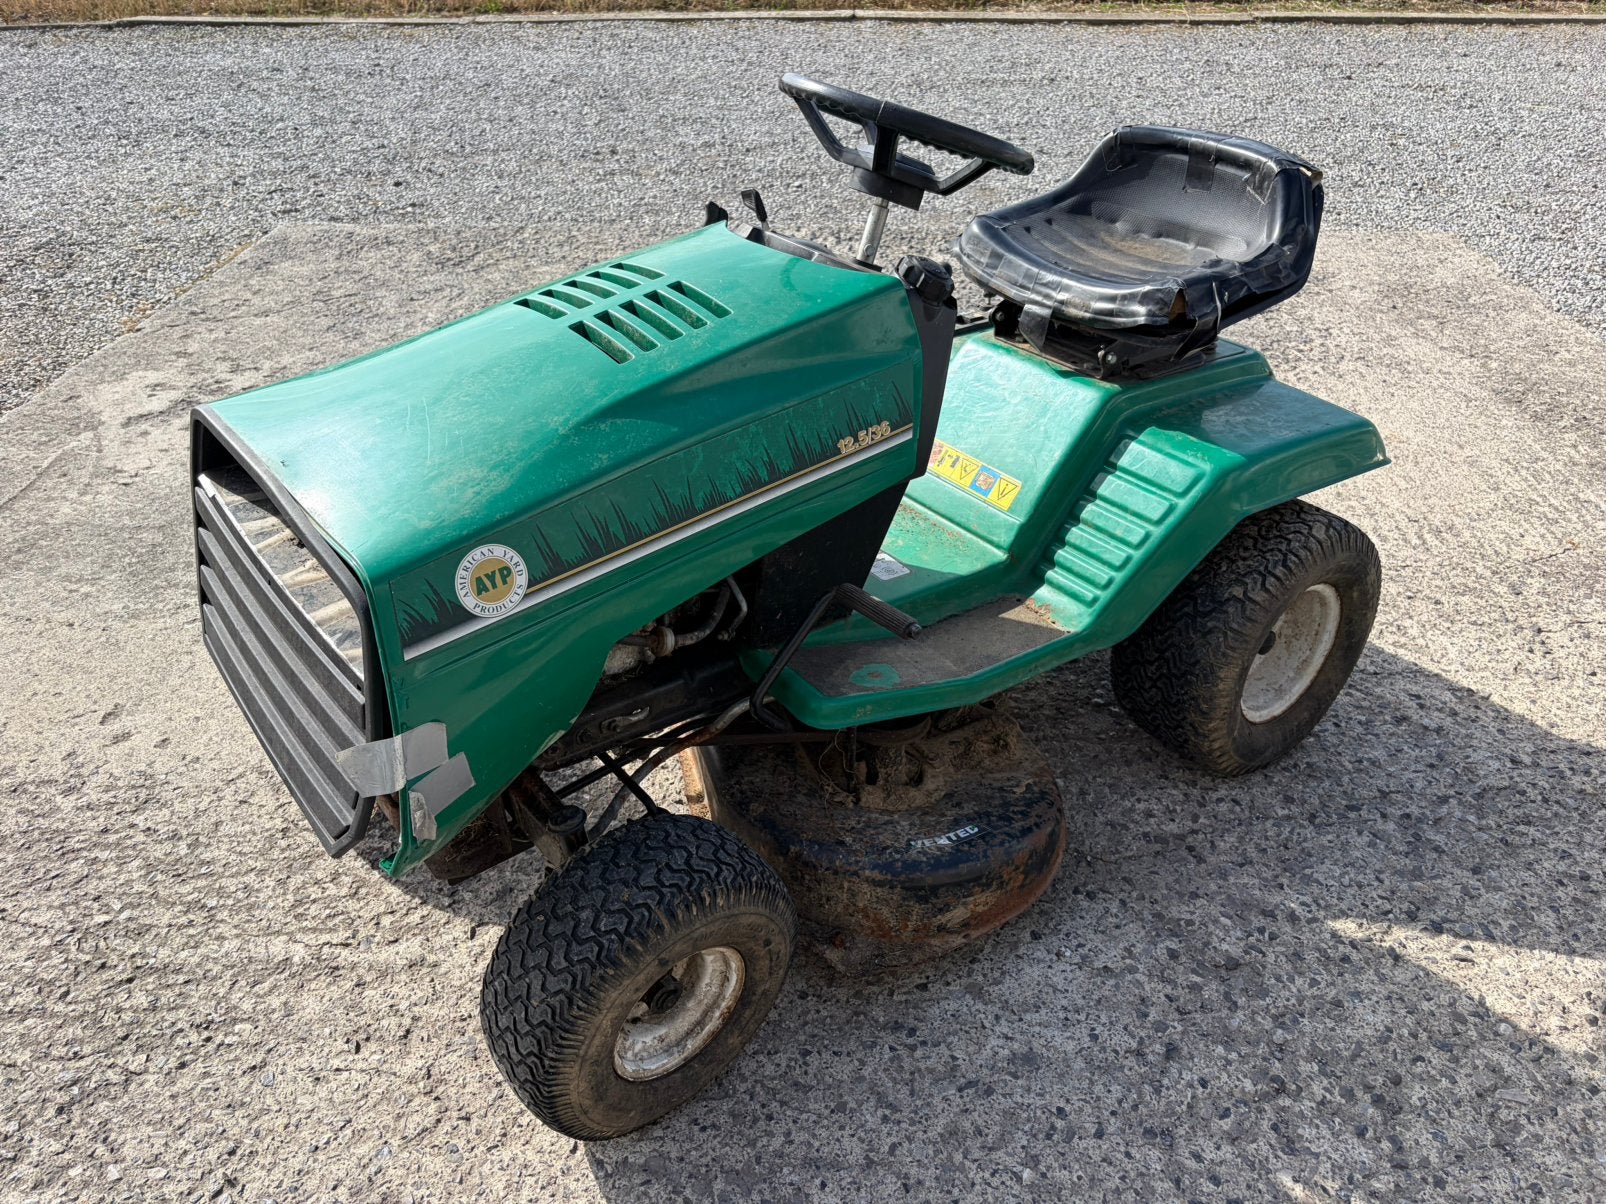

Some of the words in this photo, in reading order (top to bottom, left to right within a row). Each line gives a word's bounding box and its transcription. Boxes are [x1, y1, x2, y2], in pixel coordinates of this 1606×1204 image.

[837, 420, 891, 454] 12.5/36
[458, 547, 495, 598] AMERICAN
[501, 549, 524, 577] YARD
[475, 565, 513, 596] AYP
[472, 583, 524, 613] PRODUCTS
